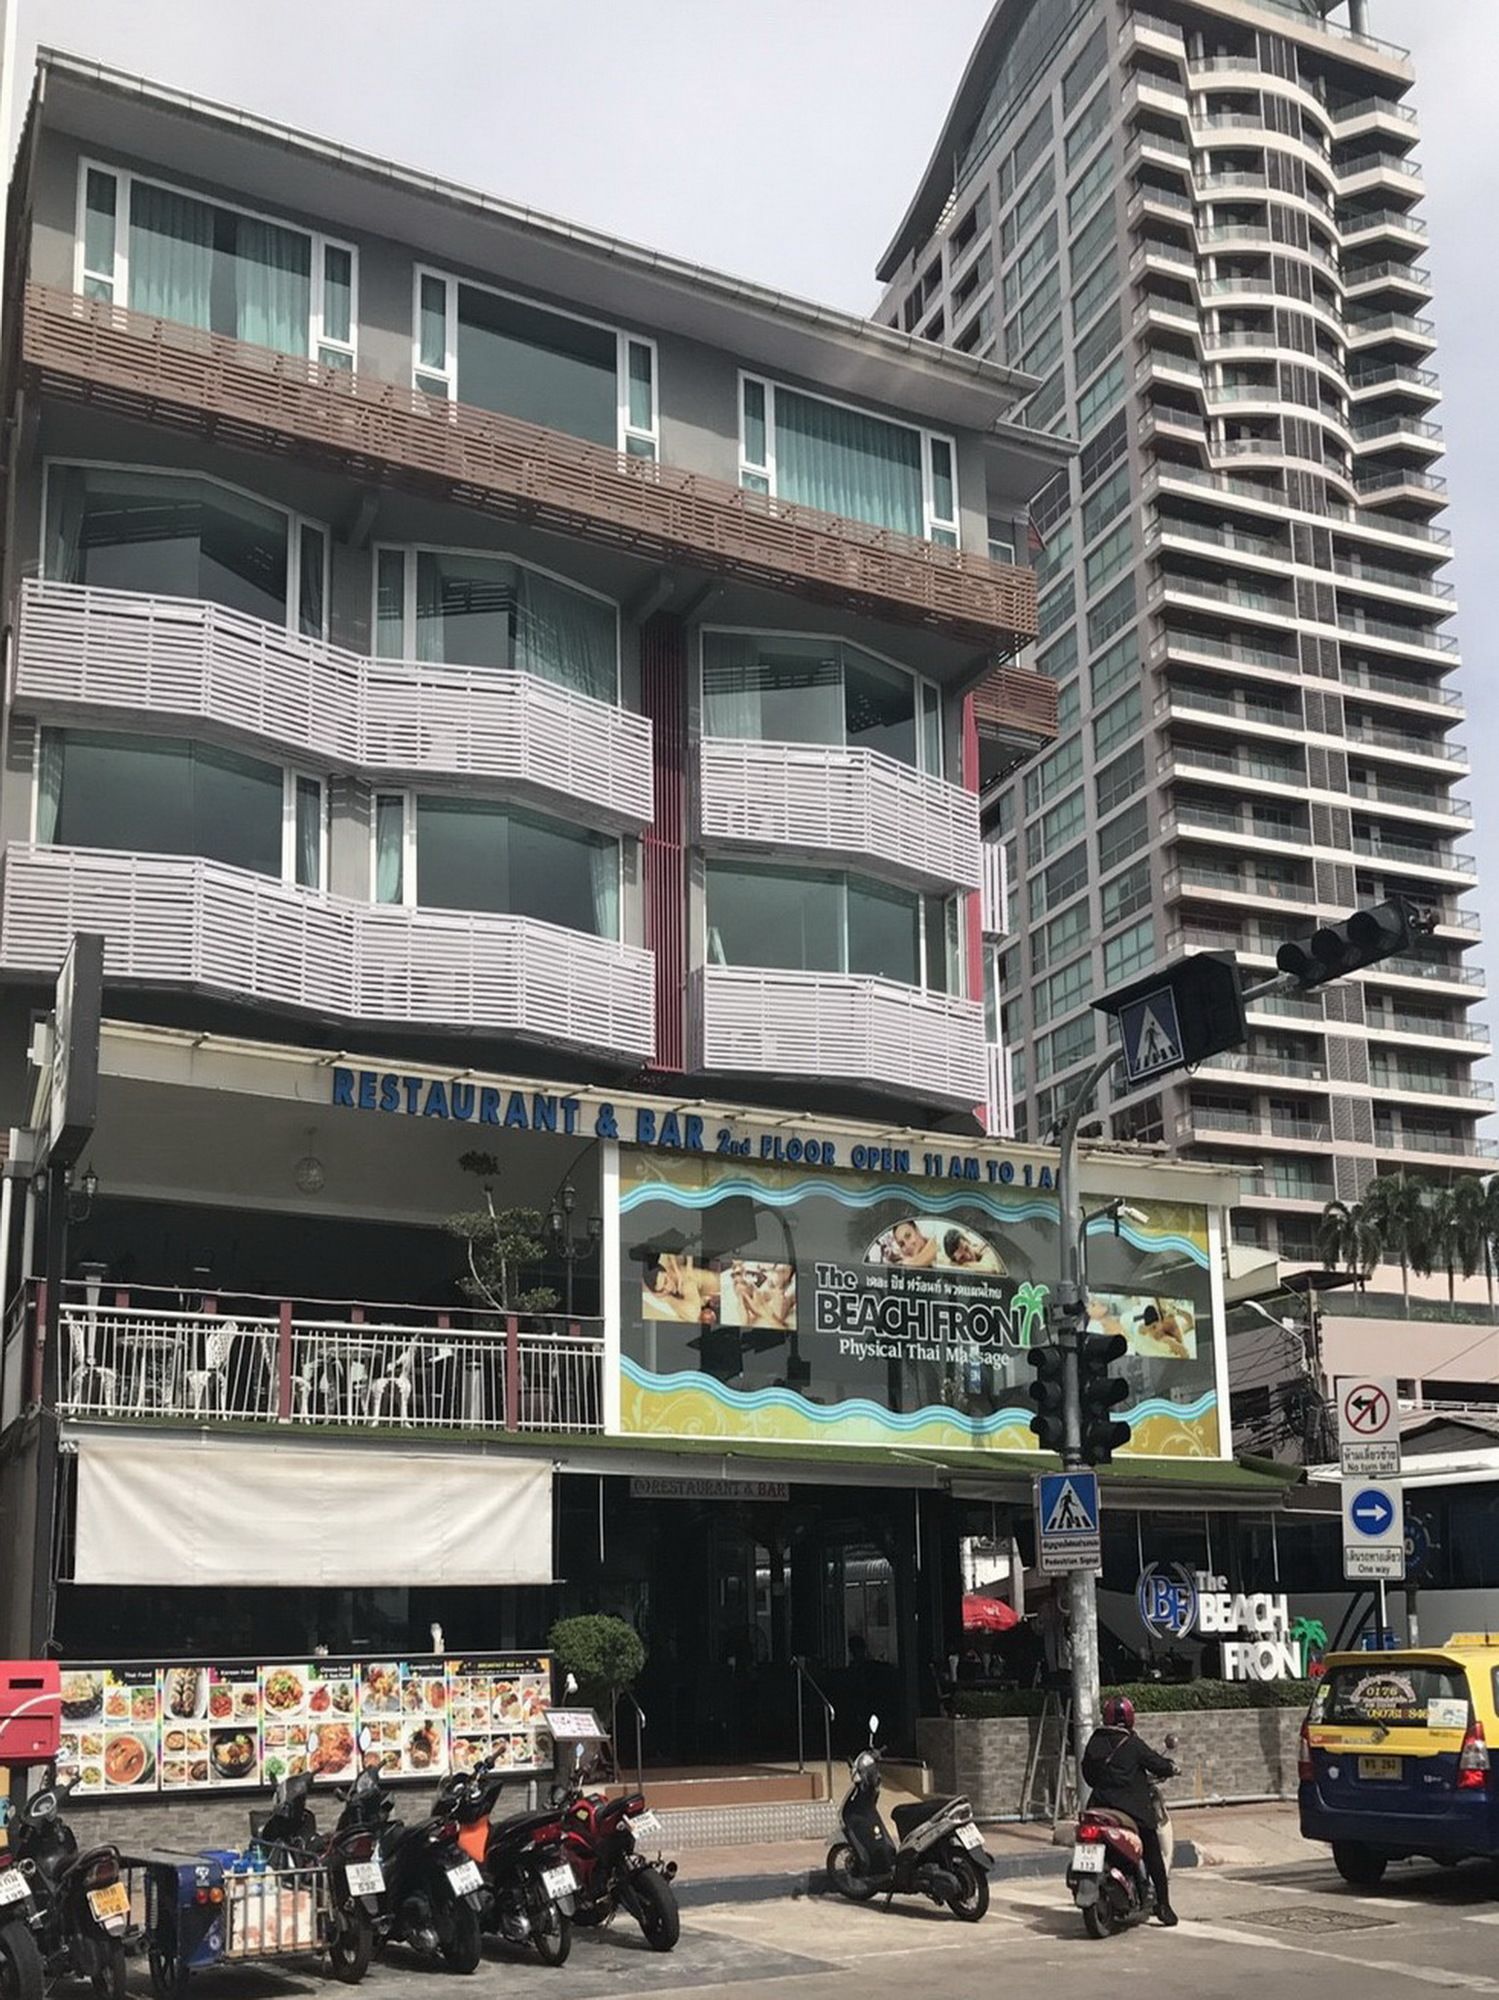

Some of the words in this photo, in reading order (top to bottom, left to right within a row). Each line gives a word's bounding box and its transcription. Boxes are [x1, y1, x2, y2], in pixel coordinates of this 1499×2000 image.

[333, 1066, 580, 1137] RESTAURANT
[595, 1102, 619, 1139] &
[637, 1107, 704, 1151] BAR
[717, 1128, 751, 1156] 2nd
[760, 1135, 835, 1166] FLOOR
[851, 1144, 910, 1173] OPEN
[987, 1159, 1014, 1184] TO
[1040, 1166, 1060, 1190] A
[815, 1262, 857, 1291] The
[839, 1338, 902, 1361] Physical
[907, 1343, 940, 1361] Thai
[1348, 1463, 1359, 1471] No
[1361, 1462, 1378, 1471] turn
[1380, 1461, 1394, 1470] left
[757, 1482, 786, 1497] BAR
[1196, 1570, 1228, 1591] The
[1358, 1563, 1373, 1574] One
[1375, 1566, 1391, 1576] way
[1199, 1593, 1290, 1632] BEACH
[1222, 1641, 1302, 1681] FRON
